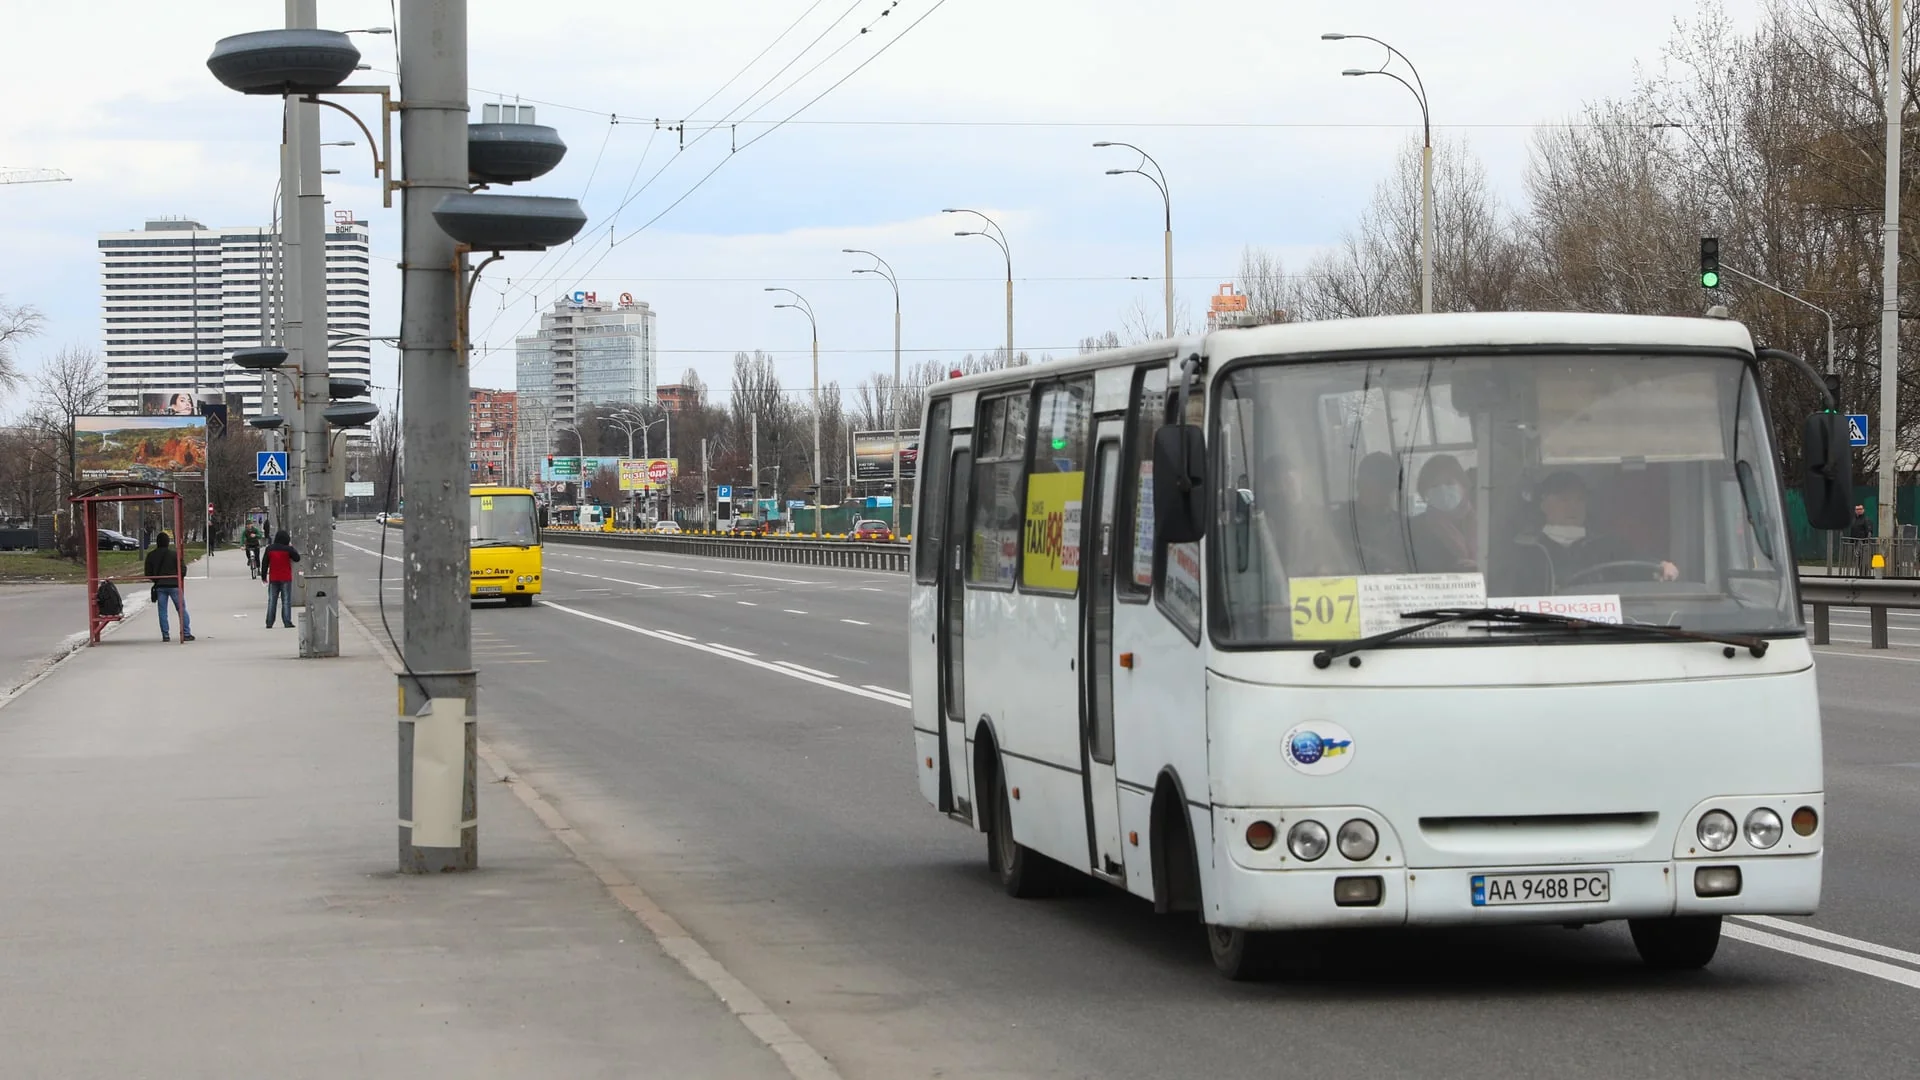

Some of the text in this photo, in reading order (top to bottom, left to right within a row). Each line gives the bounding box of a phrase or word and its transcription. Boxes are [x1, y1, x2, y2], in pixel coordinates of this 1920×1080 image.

[1294, 594, 1355, 625] 507
[1538, 601, 1616, 614] Вокзал
[1489, 880, 1516, 900] AA
[1522, 878, 1568, 899] 9488
